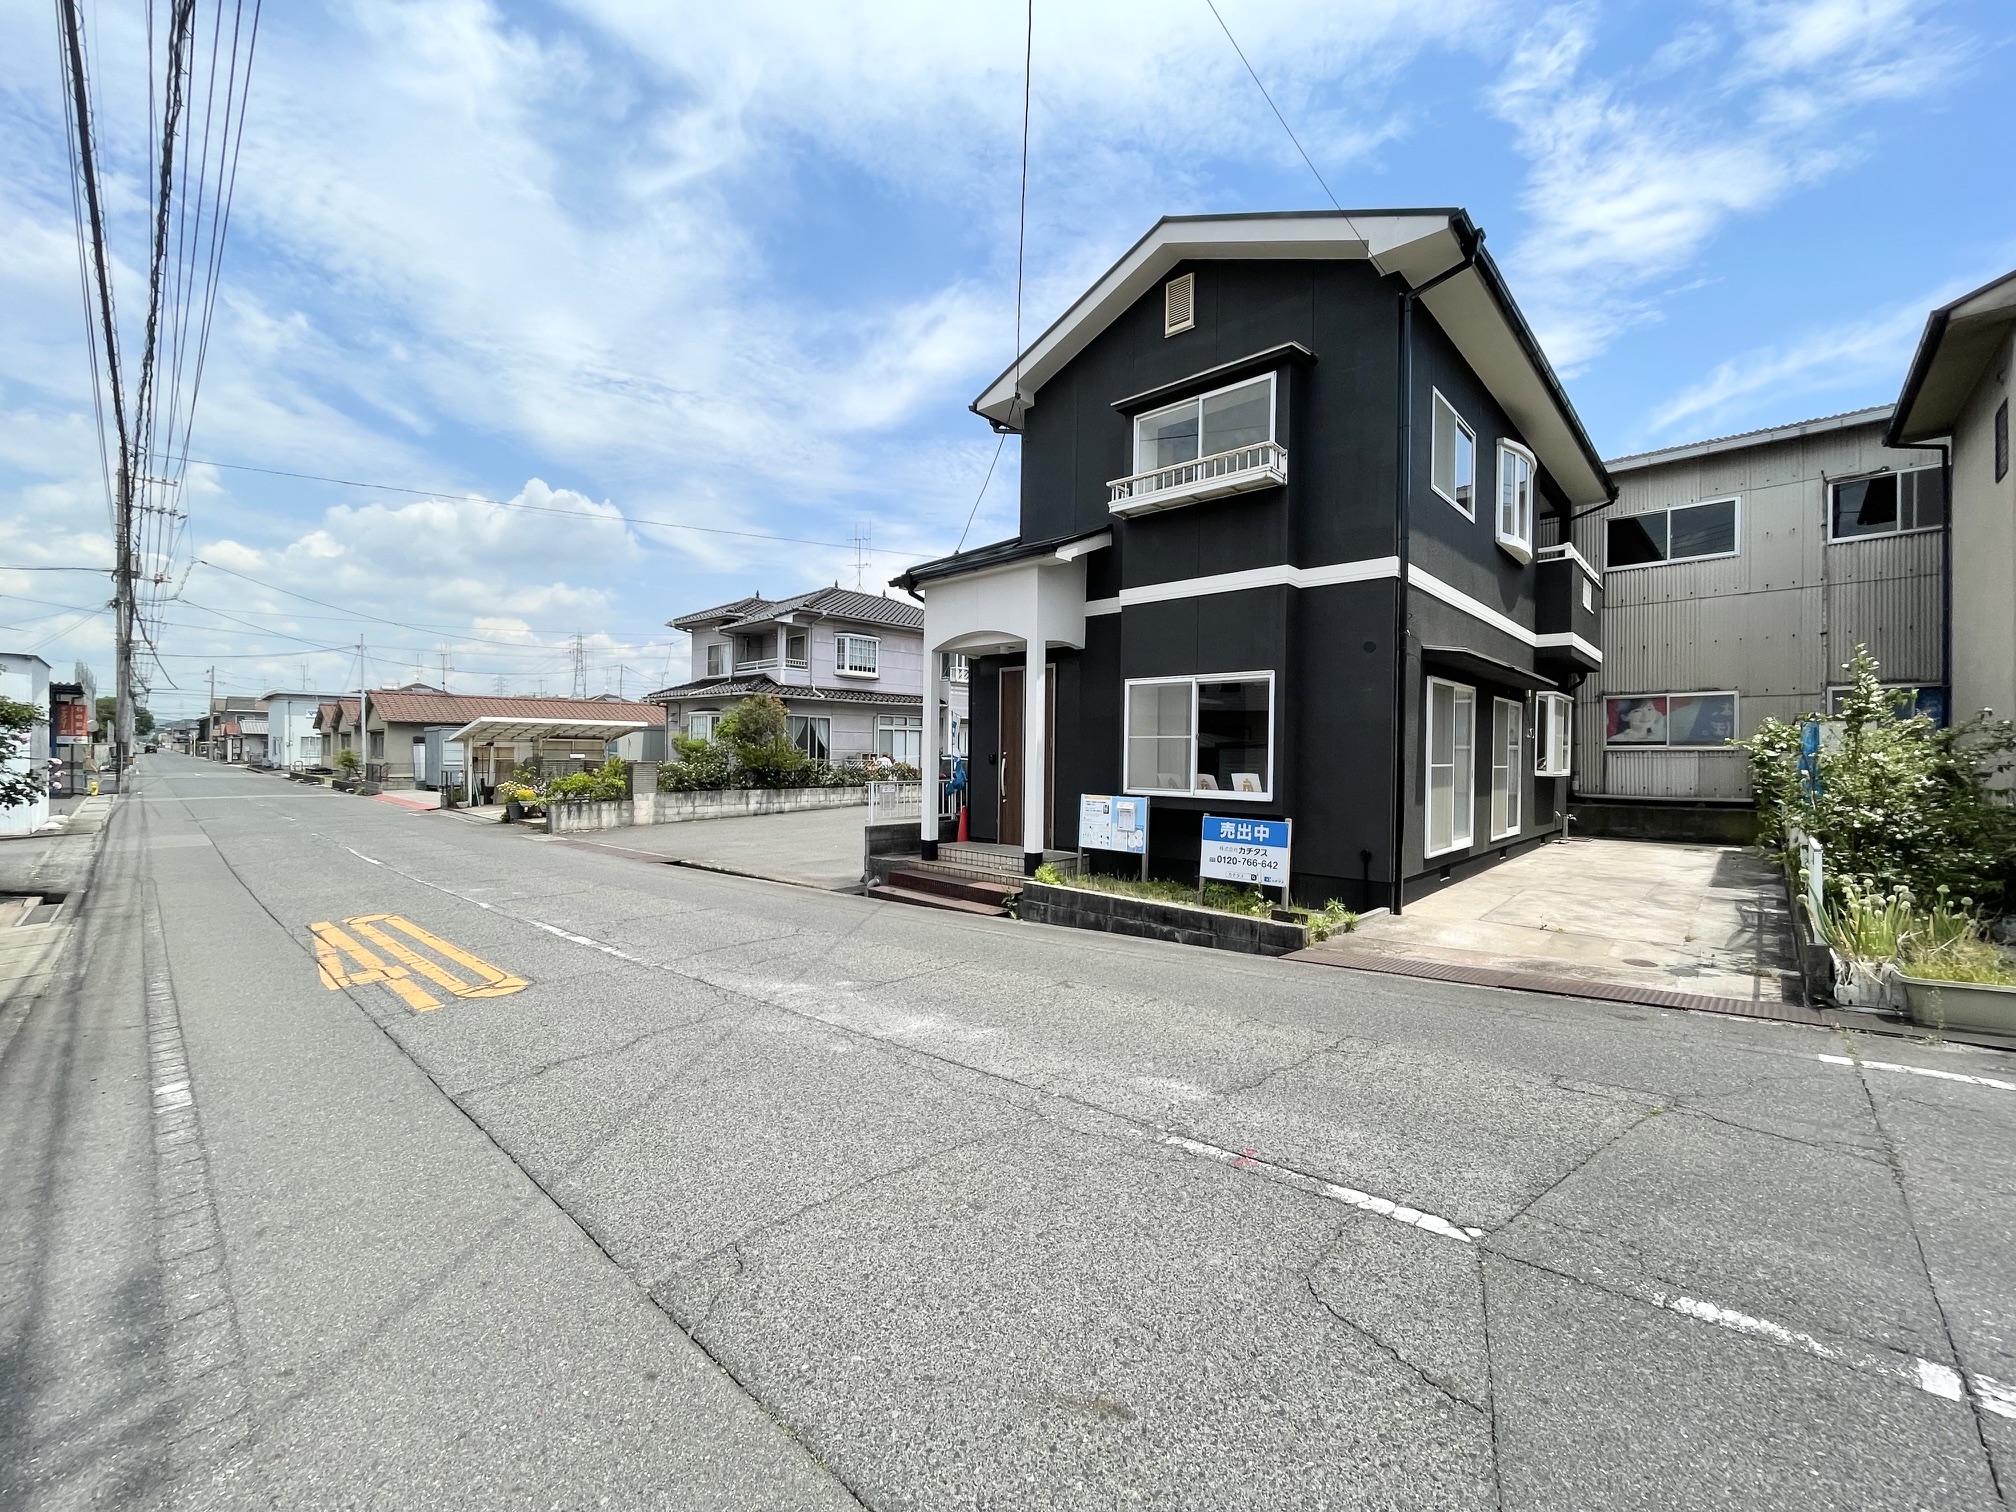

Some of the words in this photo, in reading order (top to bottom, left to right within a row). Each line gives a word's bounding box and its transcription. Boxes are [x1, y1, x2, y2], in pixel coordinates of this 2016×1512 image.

[1220, 821, 1270, 842] 売出中
[1216, 855, 1279, 870] 0120-766-642
